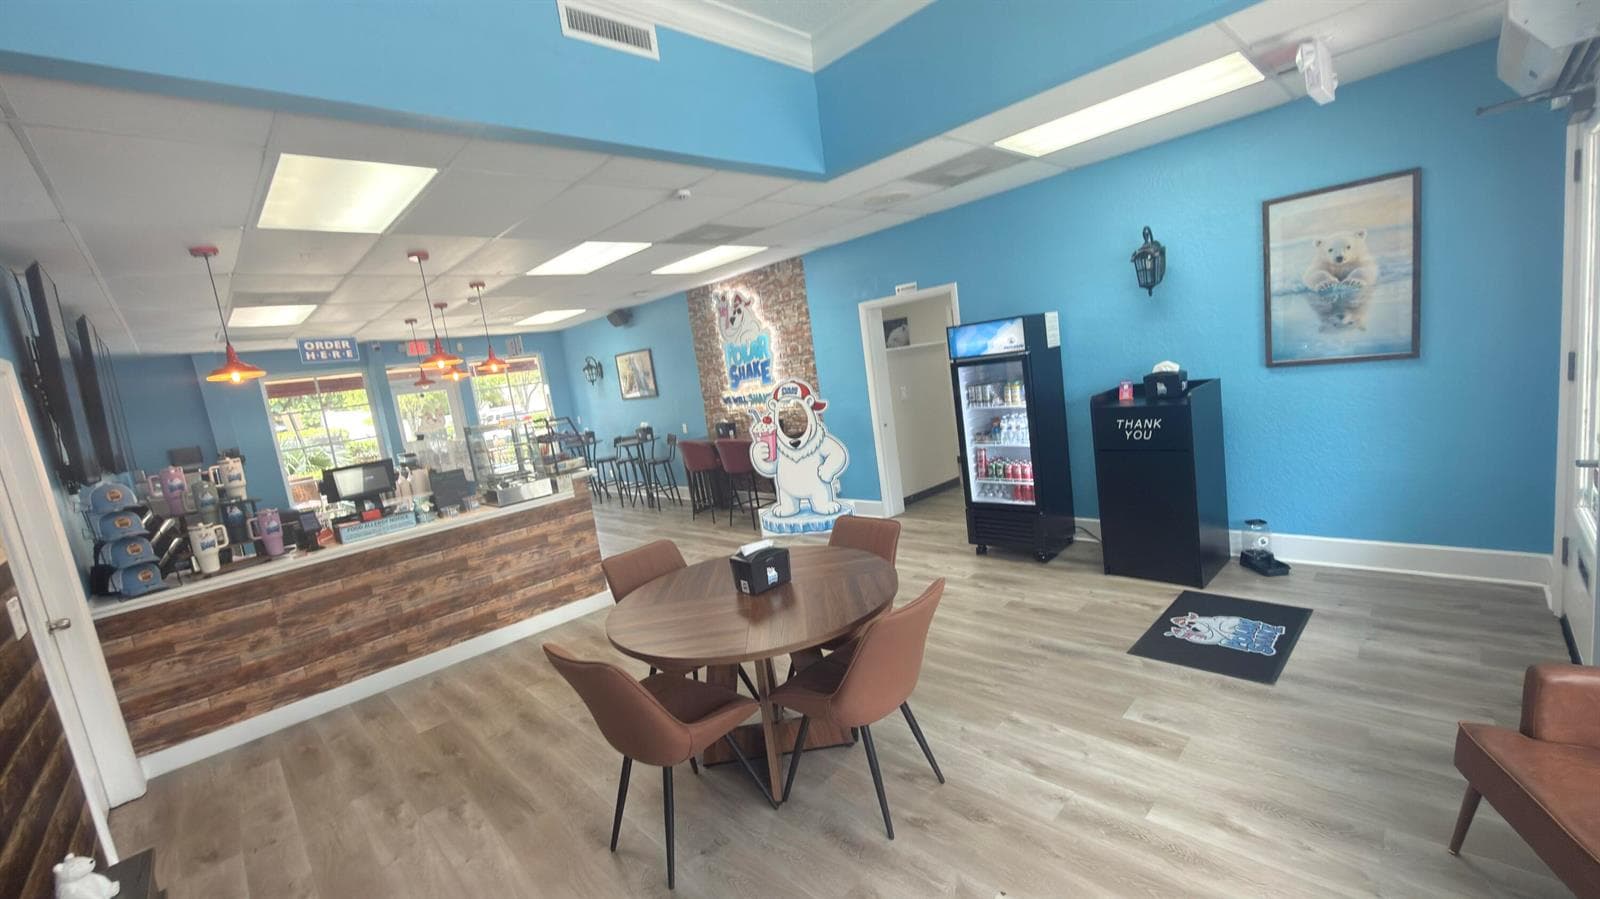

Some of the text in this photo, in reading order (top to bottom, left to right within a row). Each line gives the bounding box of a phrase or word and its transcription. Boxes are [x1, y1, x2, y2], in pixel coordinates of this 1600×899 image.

[304, 341, 351, 350] ORDER
[726, 334, 769, 369] POLAR
[729, 360, 771, 390] SHAKE
[1116, 418, 1162, 429] THANK
[1125, 430, 1152, 440] YOU
